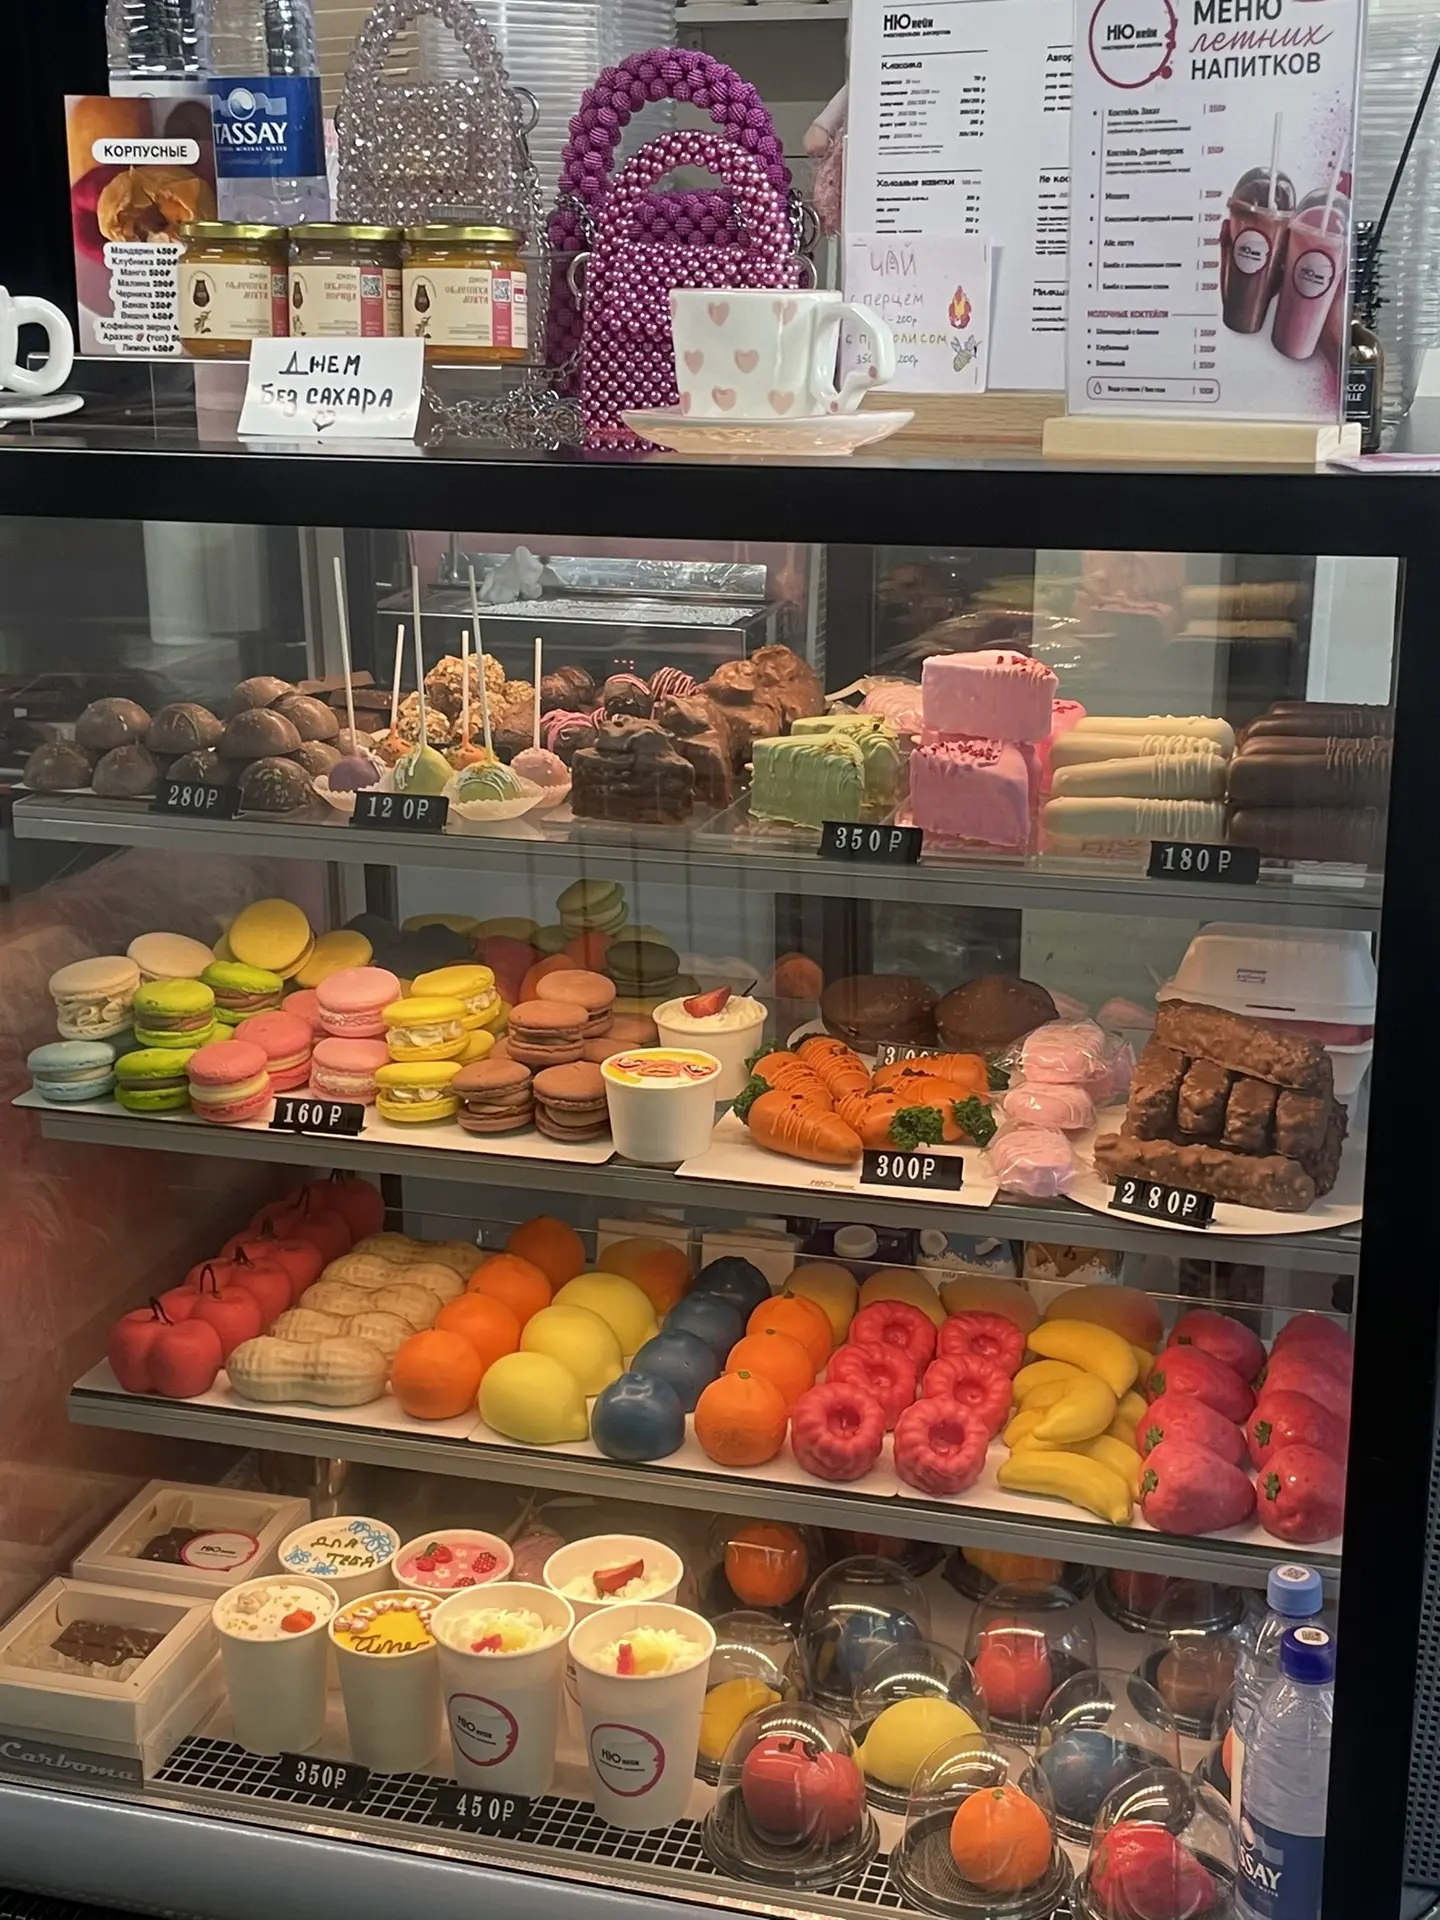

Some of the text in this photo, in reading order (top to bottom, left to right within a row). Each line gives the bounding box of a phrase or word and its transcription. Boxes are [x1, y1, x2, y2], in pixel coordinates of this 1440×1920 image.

[1193, 0, 1282, 25] МЕНЮ
[1189, 24, 1334, 53] летних
[1191, 52, 1321, 80] НАПИТКОВ
[212, 122, 288, 145] TASSAY
[104, 145, 188, 157] КОРПУСНЫЕ
[110, 246, 154, 255] Мандарин
[112, 257, 154, 267] Клубника
[117, 279, 150, 287] Малина
[120, 268, 147, 276] Манго
[116, 290, 152, 298] Черника
[122, 301, 148, 309] Банан
[100, 321, 144, 331] Кофейное
[103, 332, 133, 341] Арахис
[167, 785, 218, 809] 280₽
[283, 1102, 342, 1127] 160₽
[876, 1155, 936, 1180] 300₽
[0, 1742, 139, 1782] Carboma
[295, 1760, 346, 1790] 350₽
[455, 1794, 515, 1822] 450₽
